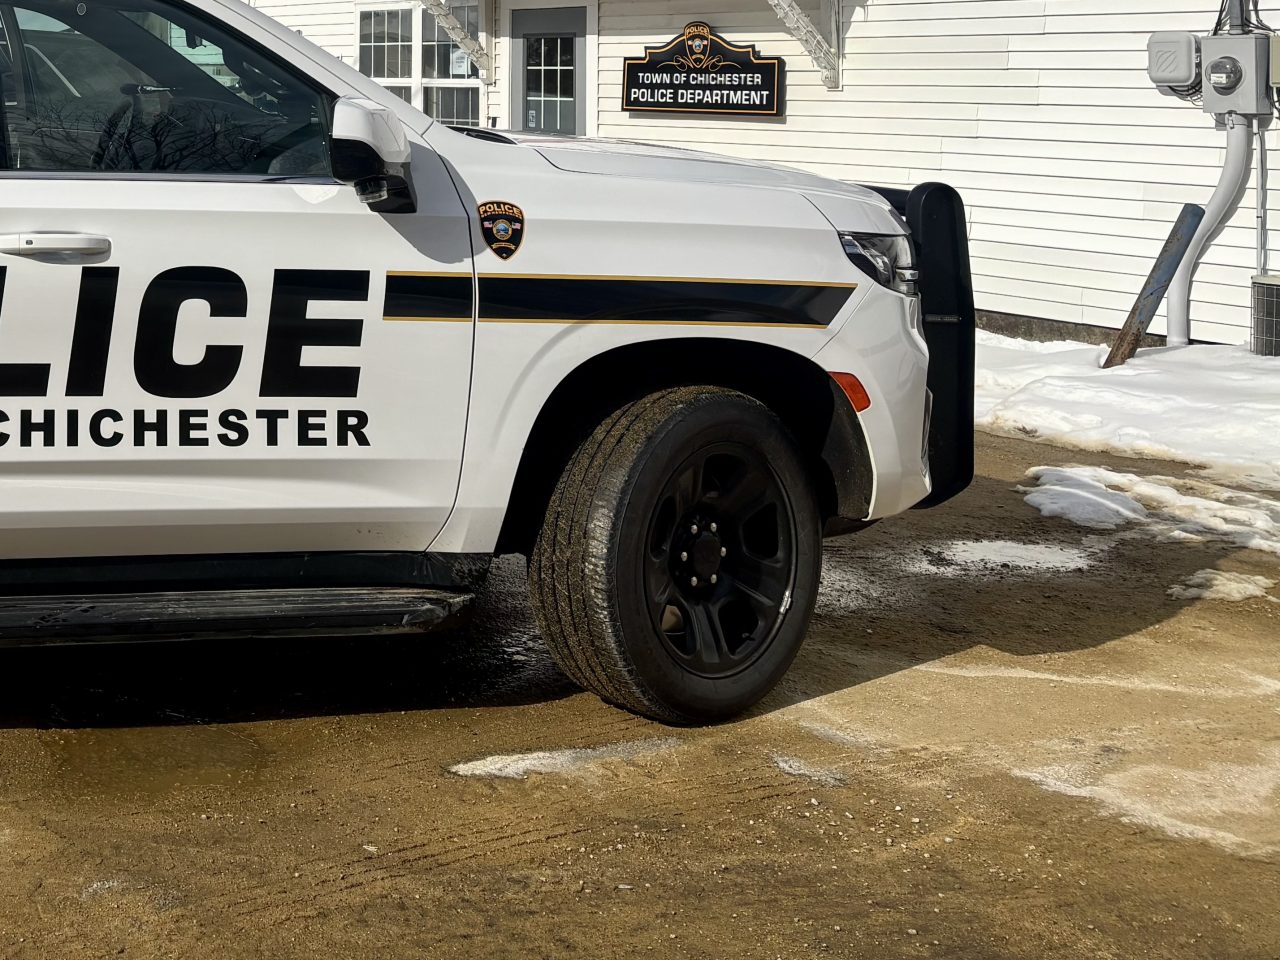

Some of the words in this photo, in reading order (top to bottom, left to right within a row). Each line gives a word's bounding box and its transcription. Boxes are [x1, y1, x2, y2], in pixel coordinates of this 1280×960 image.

[686, 25, 708, 36] POLICE
[638, 72, 670, 84] TOWN
[673, 73, 687, 85] OF
[689, 73, 762, 86] CHICHESTER
[630, 88, 674, 103] POLICE
[678, 89, 770, 105] DEPARTMENT
[479, 203, 522, 218] POLICE
